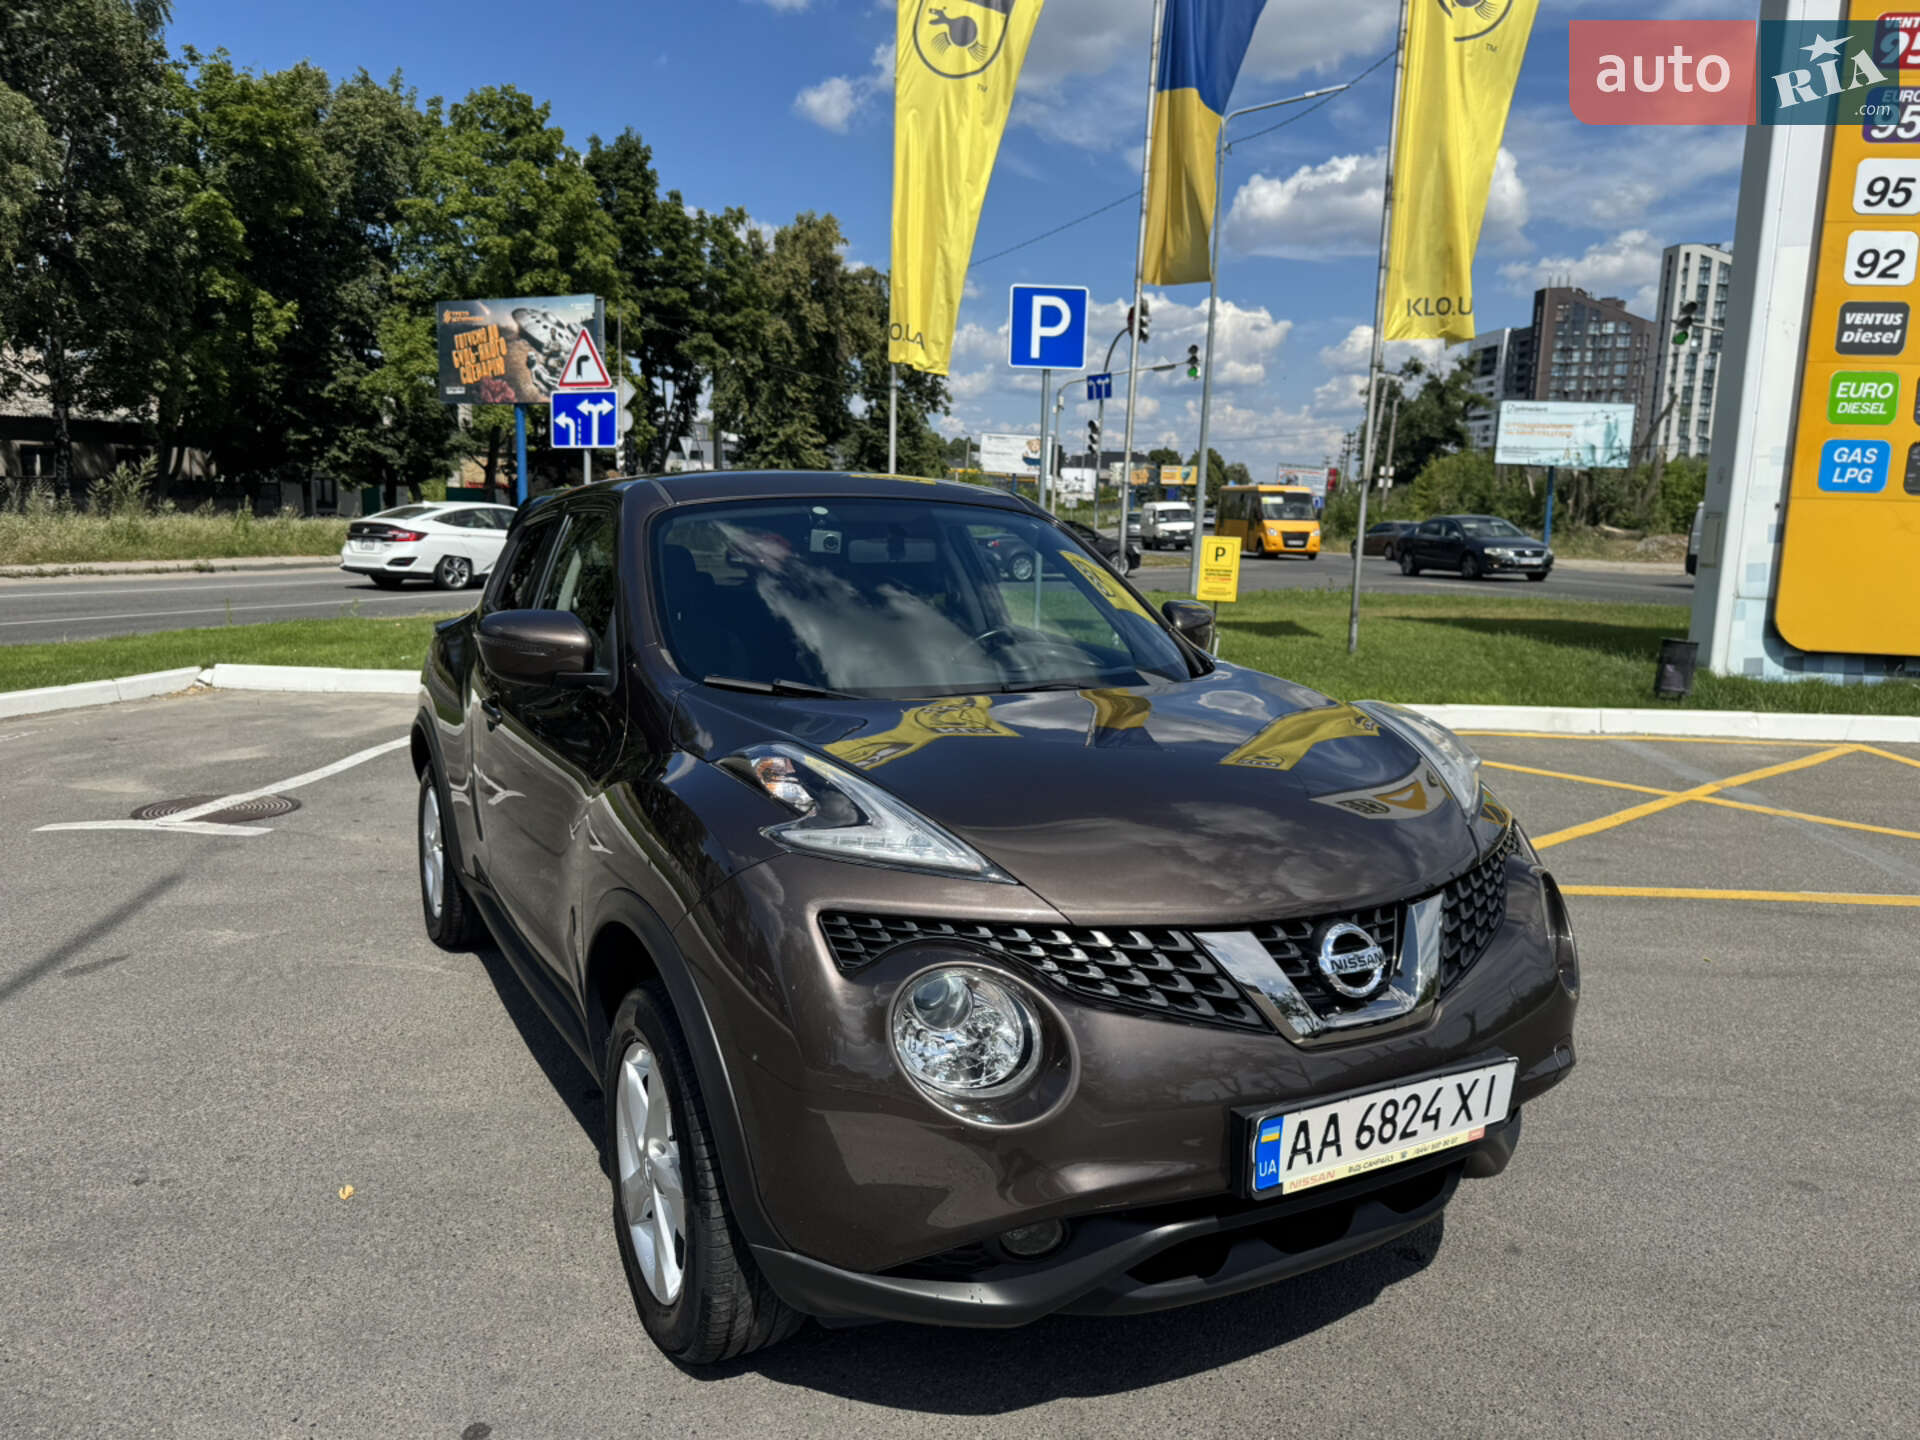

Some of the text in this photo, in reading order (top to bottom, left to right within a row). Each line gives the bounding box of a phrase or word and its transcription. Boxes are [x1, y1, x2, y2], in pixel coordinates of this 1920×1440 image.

[1863, 176, 1916, 208] 95
[1854, 248, 1906, 279] 92
[1030, 295, 1072, 359] P
[1845, 312, 1904, 326] VENTUS
[1836, 382, 1895, 399] EURO
[1836, 402, 1887, 414] DIESEL
[1833, 447, 1879, 464] GAS
[1832, 467, 1873, 484] LPG
[1215, 546, 1226, 562] P
[1331, 952, 1383, 971] NISSAN
[1286, 1074, 1496, 1171] AA 6824 XI
[1259, 1159, 1278, 1177] UA
[1289, 1169, 1336, 1190] NISSAN
